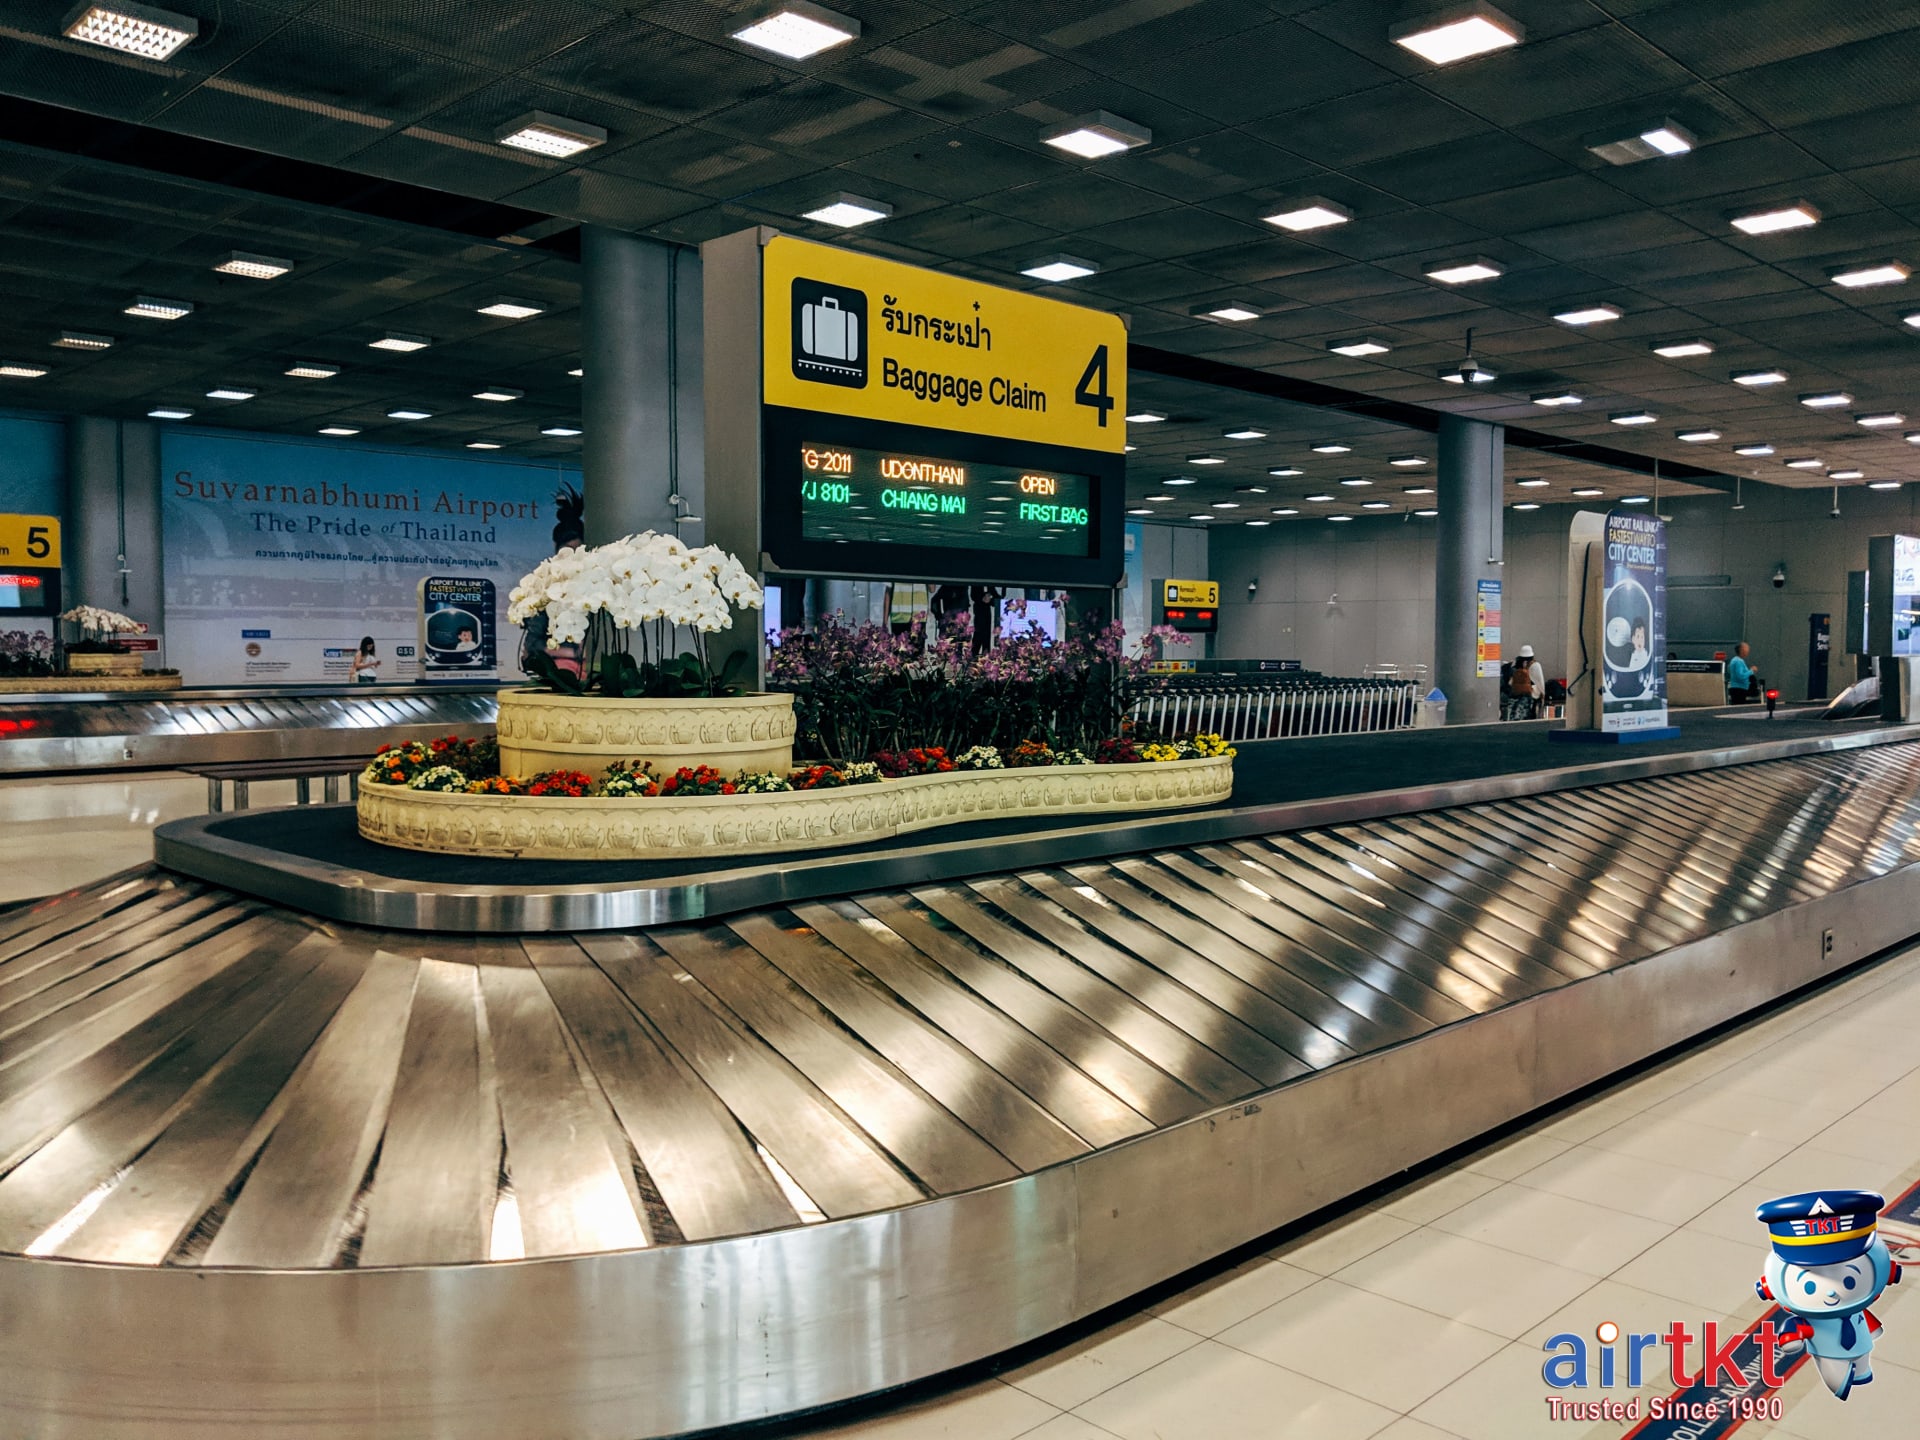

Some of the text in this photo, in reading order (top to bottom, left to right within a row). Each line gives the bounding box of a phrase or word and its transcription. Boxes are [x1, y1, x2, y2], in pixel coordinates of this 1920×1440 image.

[881, 294, 992, 351] รับกระเป๋า
[882, 357, 1047, 413] Baggage Claim
[1074, 344, 1115, 428] 4
[801, 449, 1055, 495] G 2011 UDONTHANI OPEN
[174, 470, 540, 524] Suvarnabhumi Airport
[821, 484, 850, 503] 8101
[881, 488, 939, 513] CHIANG
[941, 496, 966, 514] MAI
[1019, 502, 1060, 523] FIRST
[1061, 505, 1089, 526] BAG
[250, 512, 497, 544] The Pride of Thailand
[1609, 516, 1632, 529] AIRPORT
[1633, 519, 1644, 531] RAIL
[1609, 529, 1633, 544] FASTEST
[26, 526, 51, 559] 5
[1608, 543, 1655, 564] CITY CENTER
[429, 592, 481, 601] CITY CENTER
[1208, 587, 1216, 604] 5
